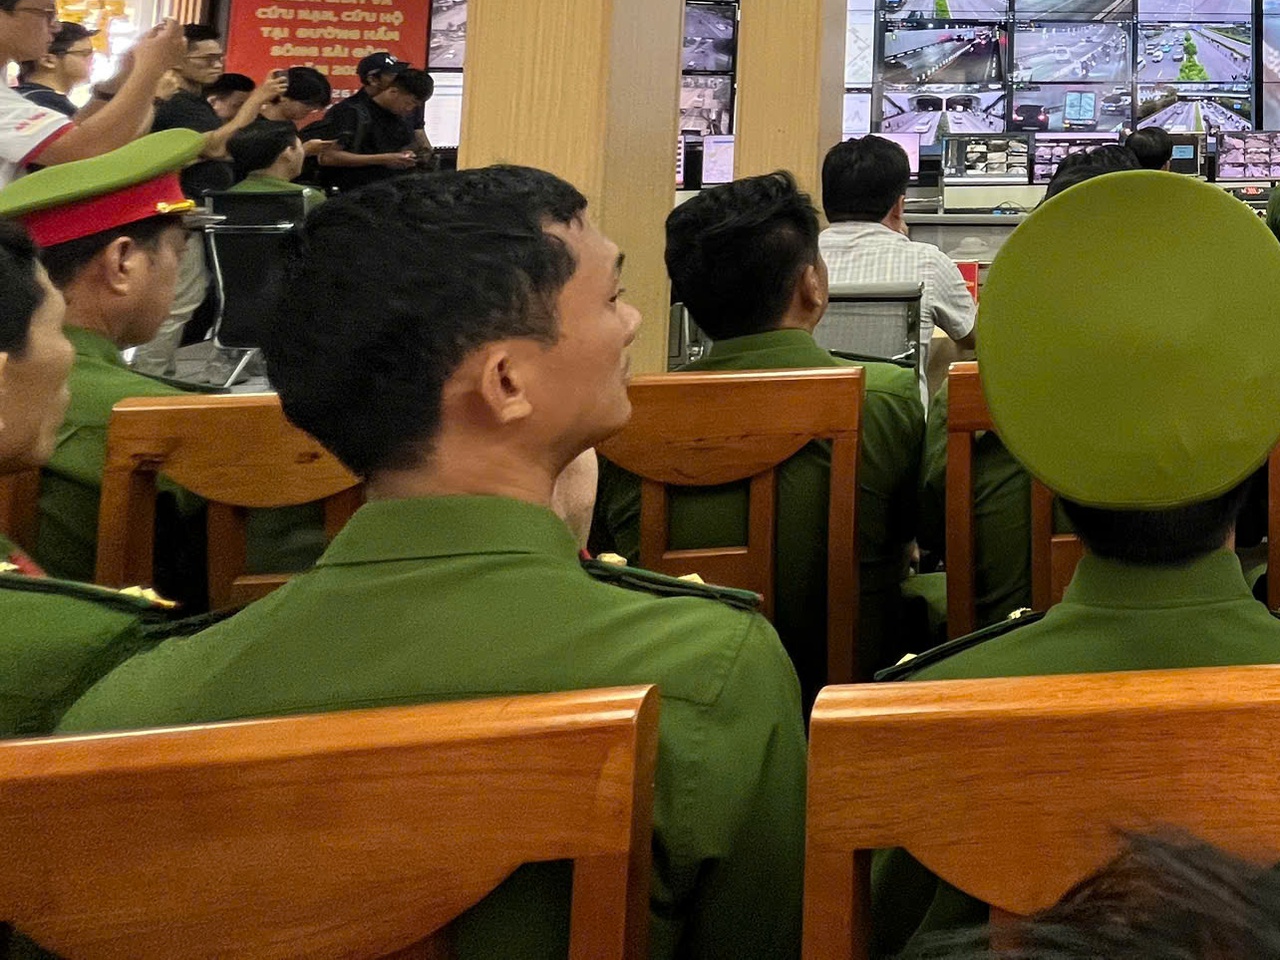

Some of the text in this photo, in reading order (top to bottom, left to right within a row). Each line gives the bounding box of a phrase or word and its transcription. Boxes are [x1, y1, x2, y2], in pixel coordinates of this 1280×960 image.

[255, 5, 295, 20] CỨU
[341, 8, 378, 23] CỨU
[379, 10, 404, 27] HỘ
[260, 26, 290, 41] TẠI
[269, 42, 320, 57] SÔNG
